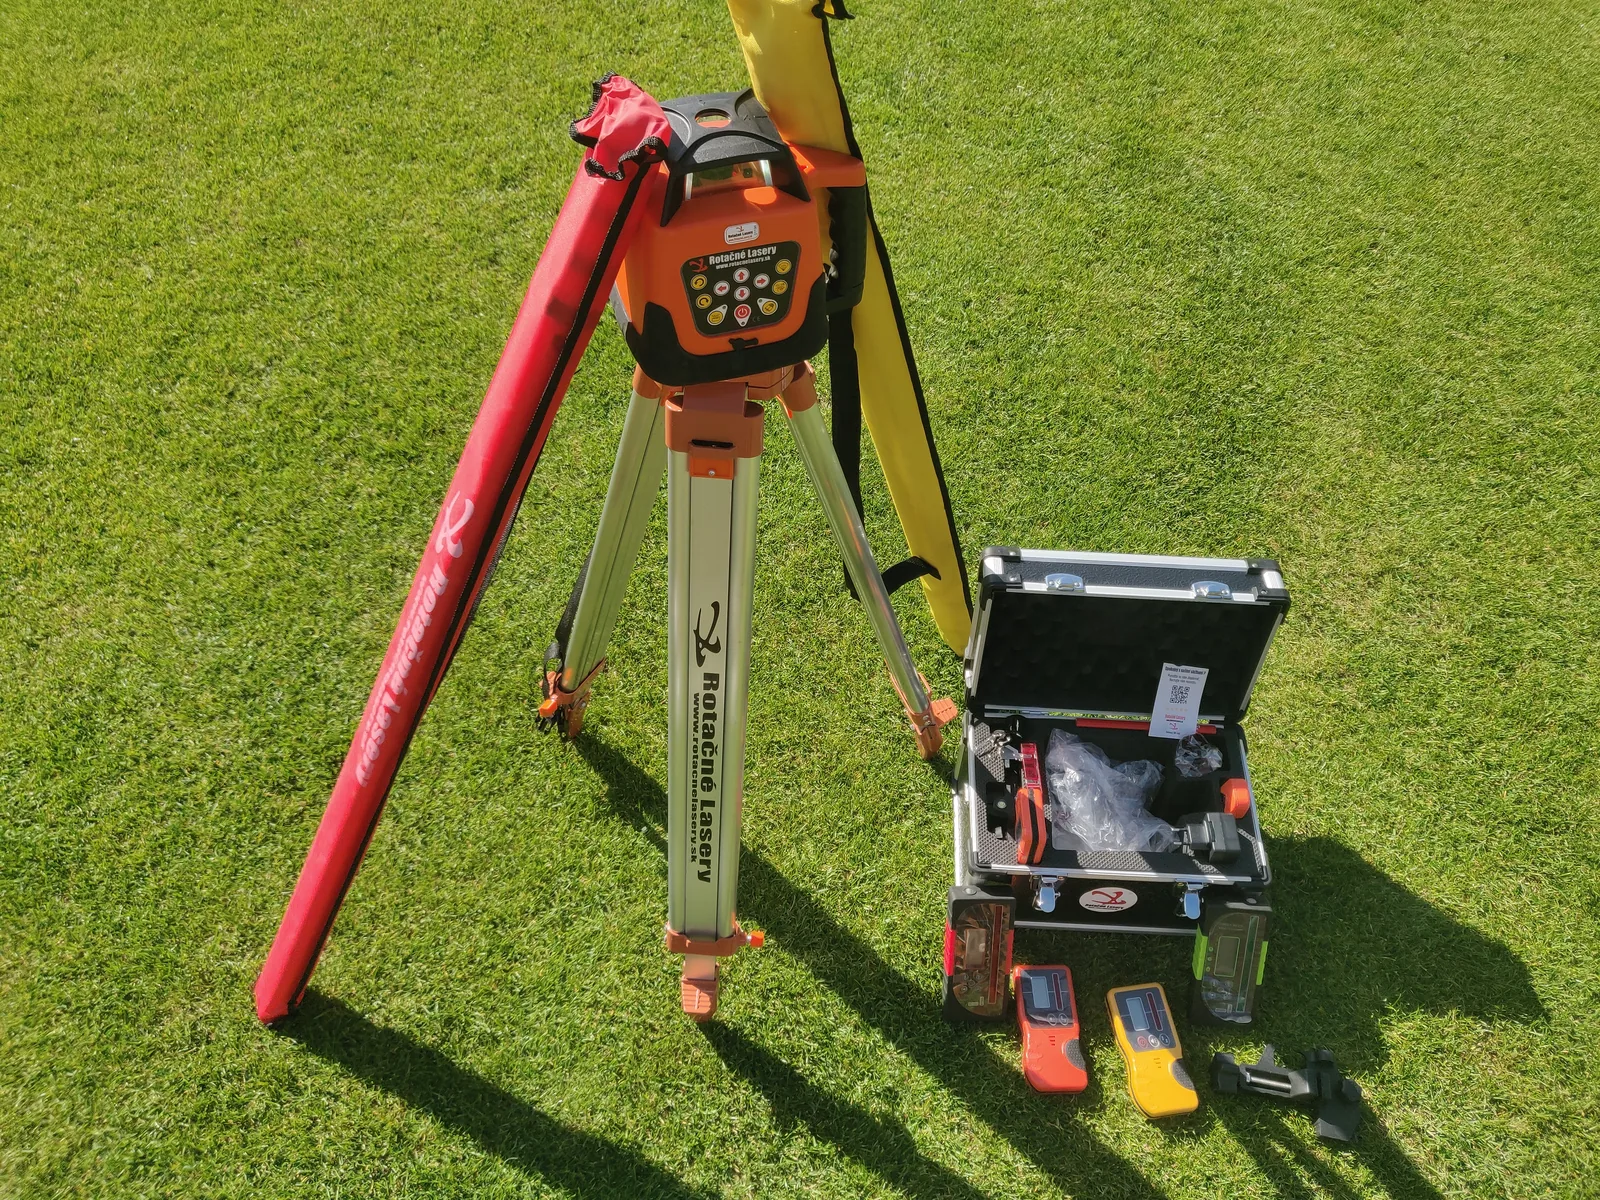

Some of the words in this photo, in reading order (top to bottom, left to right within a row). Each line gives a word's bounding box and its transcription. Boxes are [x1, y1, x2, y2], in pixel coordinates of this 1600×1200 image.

[709, 250, 746, 265] Rotačné
[747, 246, 777, 258] Lasery
[390, 562, 449, 695] Rotačné
[355, 691, 401, 787] Lasery
[690, 693, 700, 863] www.rotacnelasery.sk
[701, 672, 720, 792] Rotačné
[697, 800, 716, 883] Lasery
